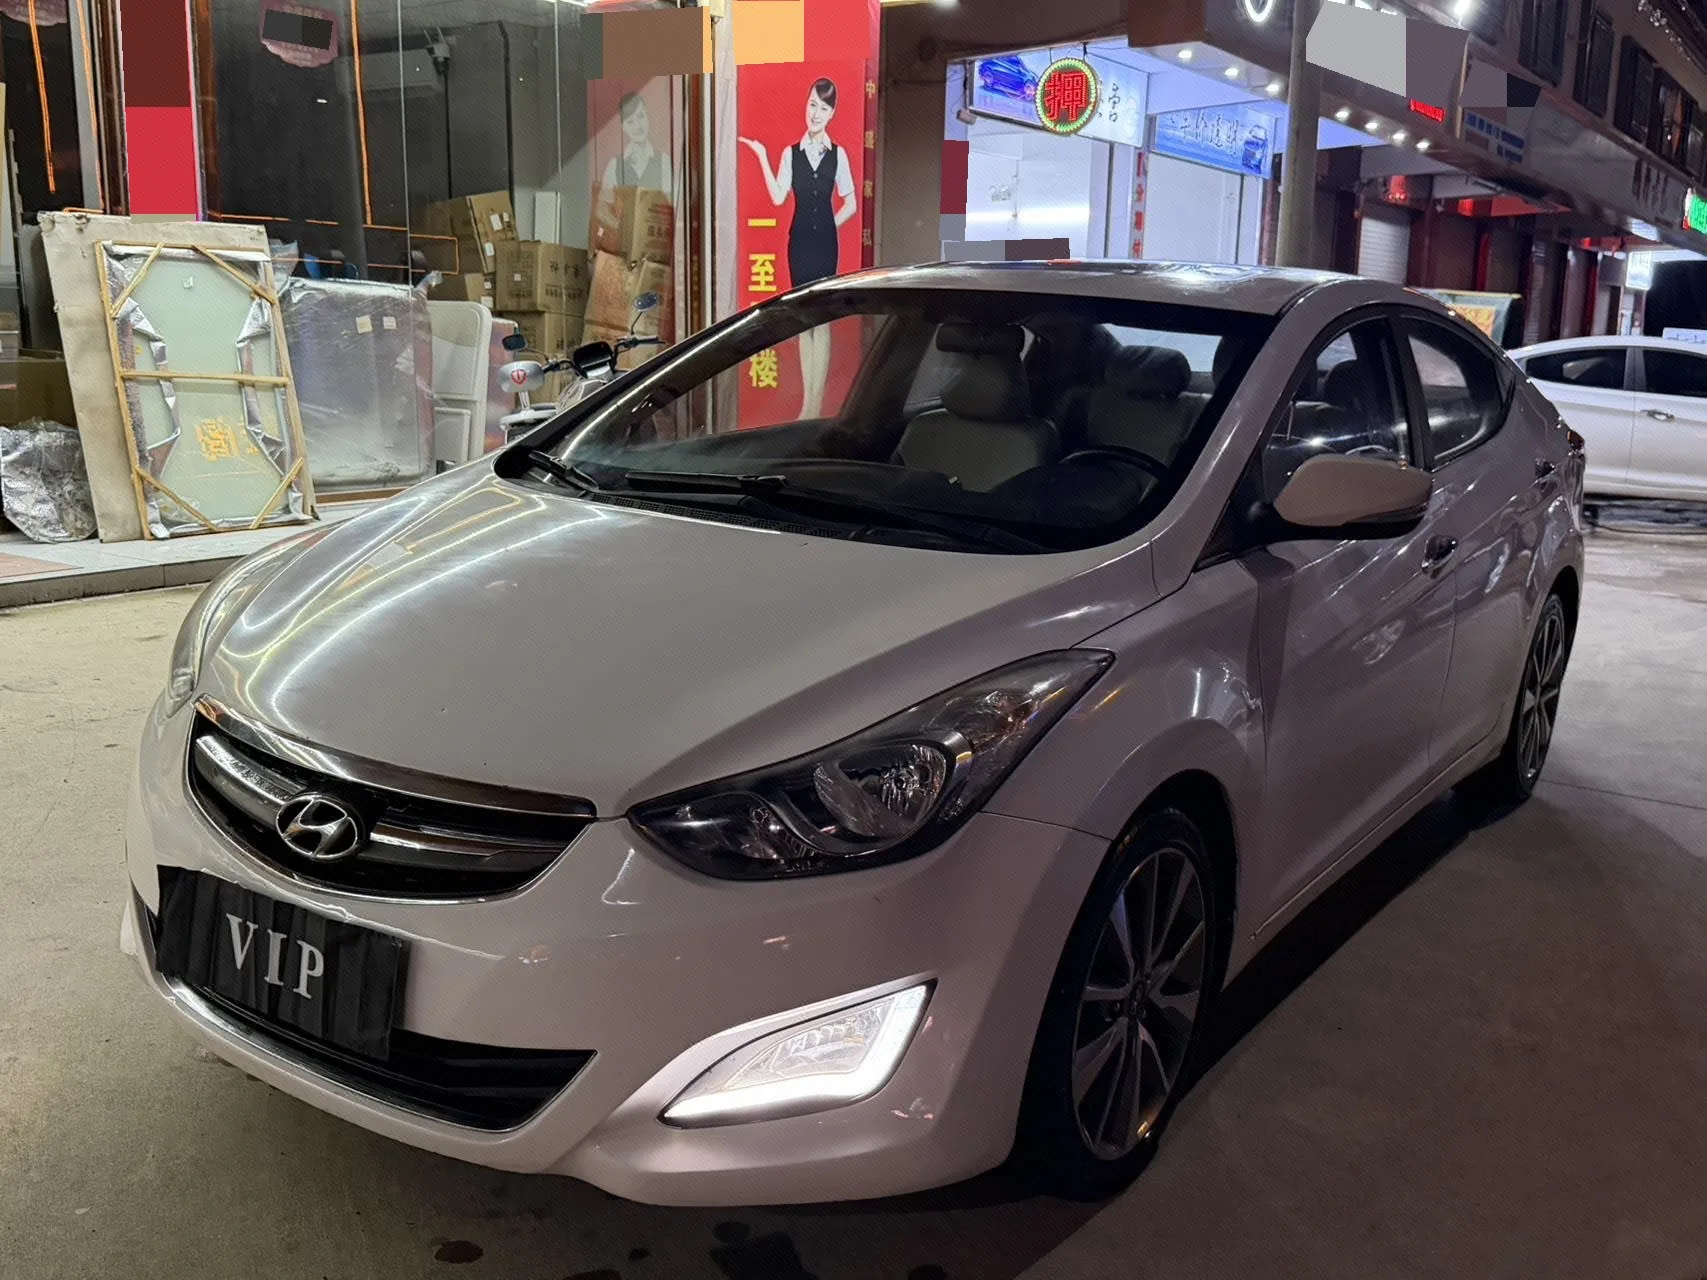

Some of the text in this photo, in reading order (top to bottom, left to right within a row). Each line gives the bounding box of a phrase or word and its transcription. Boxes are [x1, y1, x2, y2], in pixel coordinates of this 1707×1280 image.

[1045, 71, 1087, 121] 押
[747, 218, 777, 388] 一至楼
[226, 912, 325, 1000] VIP
